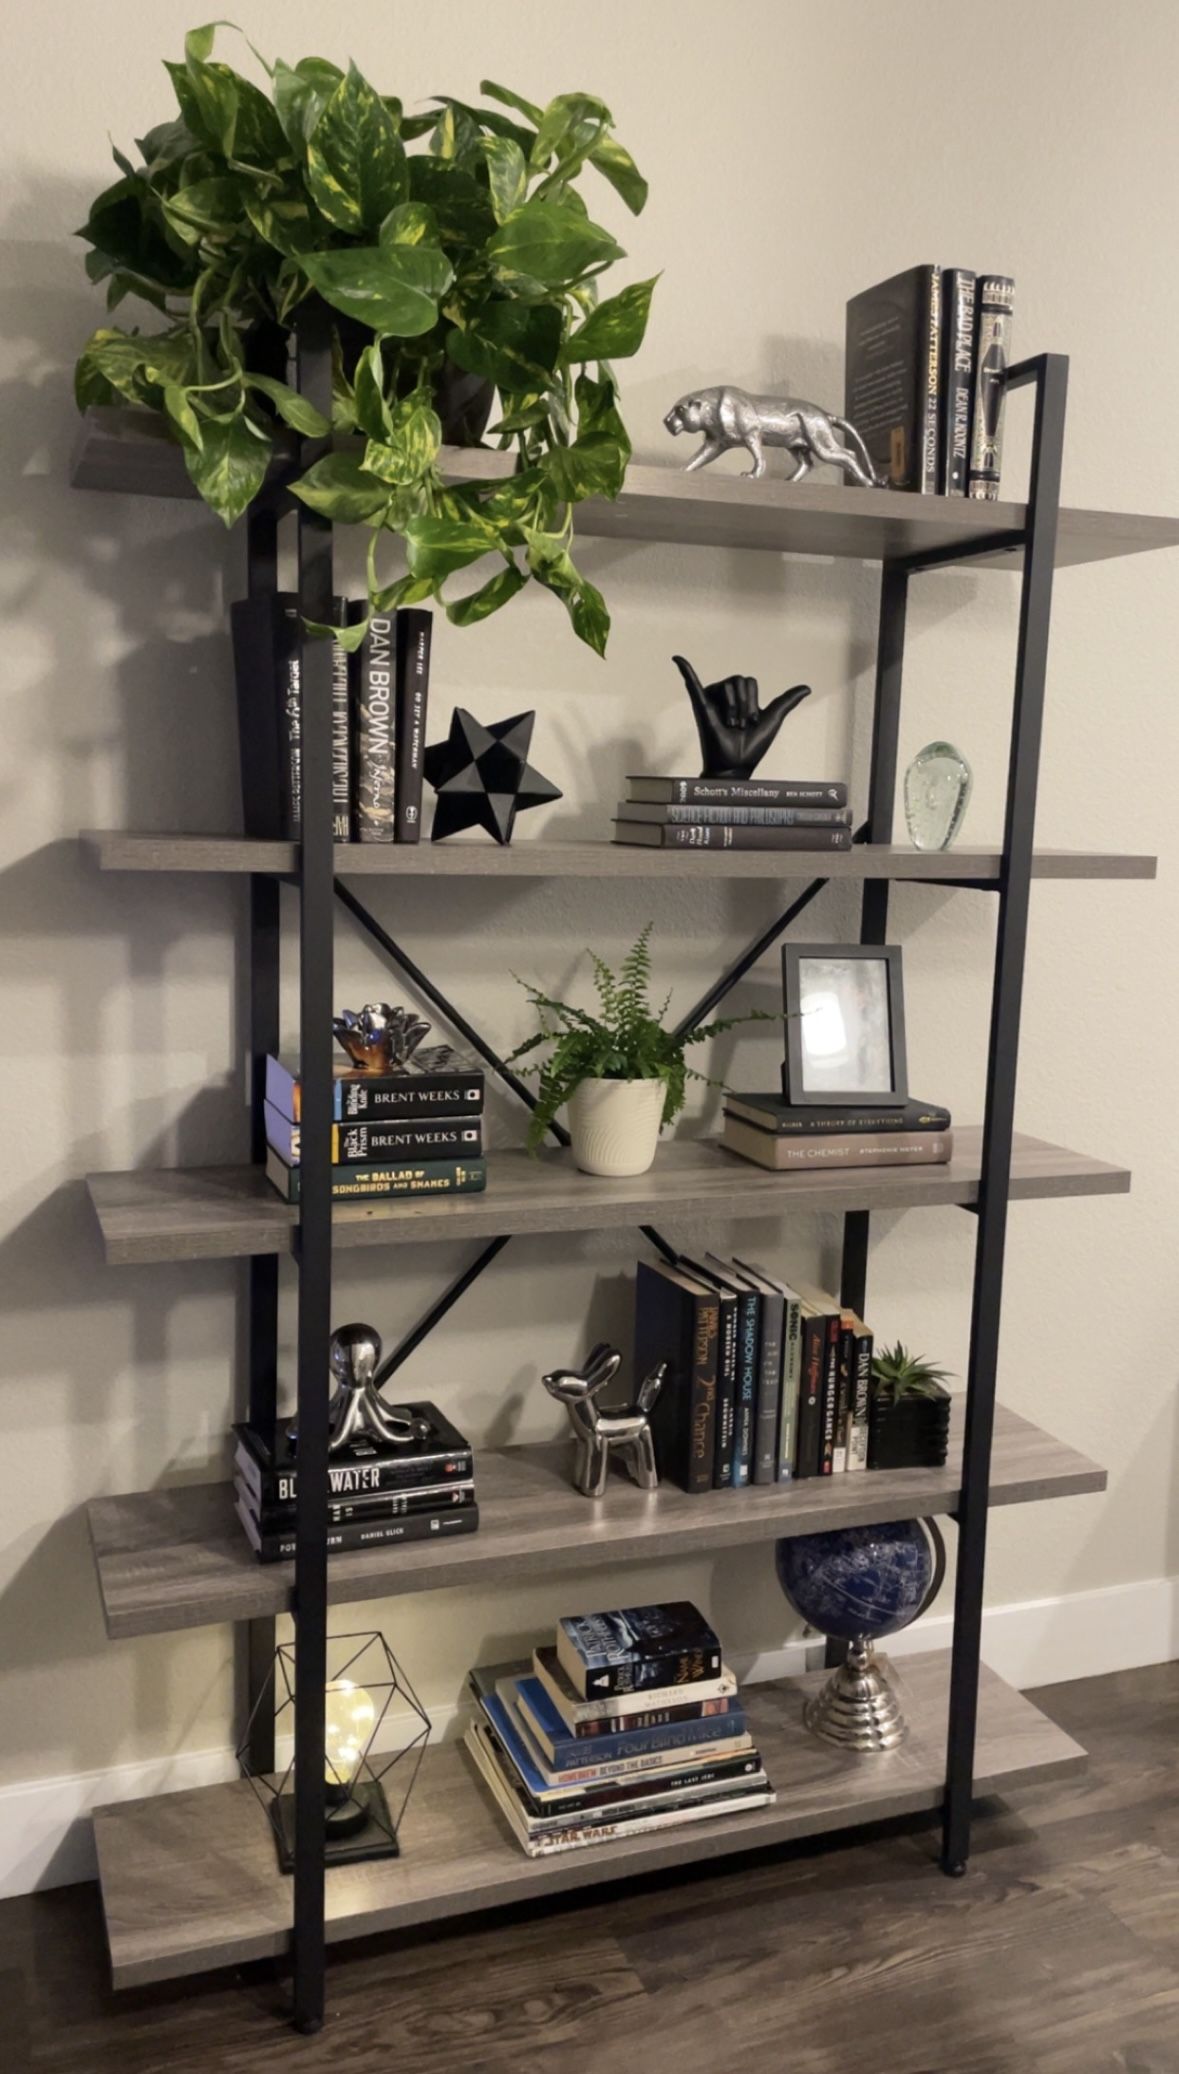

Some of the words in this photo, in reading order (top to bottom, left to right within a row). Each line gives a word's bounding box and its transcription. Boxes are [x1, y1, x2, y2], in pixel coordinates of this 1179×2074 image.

[929, 273, 940, 320] JAMES
[957, 272, 976, 303] THE
[957, 303, 973, 332] BAD
[926, 320, 939, 395] PATTERSON
[954, 332, 972, 373] PLACE
[927, 396, 937, 410] 22
[955, 387, 969, 413] DEAN
[926, 412, 937, 473] SECONDS
[952, 421, 968, 459] KOONTZ
[369, 617, 391, 666] DAN
[287, 659, 300, 696] Target
[368, 670, 390, 754] BROWN
[288, 720, 300, 741] The
[693, 786, 728, 797] Schott's
[730, 786, 780, 800] Miscellany
[358, 1089, 368, 1109] Knife
[374, 1092, 414, 1103] BRENT
[417, 1089, 460, 1101] WEEKS
[347, 1128, 358, 1158] Black
[357, 1127, 368, 1157] Prism
[371, 1134, 412, 1147] BRENT
[415, 1131, 457, 1144] WEEKS
[787, 1150, 805, 1159] THE
[806, 1147, 851, 1158] CHEMIST
[332, 1181, 391, 1195] SONGBIRDS
[393, 1182, 408, 1190] AND
[410, 1178, 450, 1190] SNAKES
[355, 1173, 370, 1181] THE
[371, 1170, 413, 1182] BALLAD
[414, 1169, 425, 1178] OF
[746, 1296, 757, 1315] THE
[696, 1307, 711, 1365] PATTERSON
[788, 1303, 799, 1341] SONIC
[744, 1318, 756, 1365] SHADOW
[857, 1352, 870, 1377] DAN
[696, 1374, 715, 1401] 2nd
[742, 1366, 754, 1400] HOUSE
[827, 1370, 835, 1409] HUNGER
[855, 1379, 868, 1418] BROWN
[693, 1402, 710, 1458] Chance
[721, 1398, 729, 1448] BROWNSTEIN
[824, 1410, 833, 1441] GAMES
[360, 1530, 384, 1540] DANIEL
[599, 1762, 625, 1776] BEYOND
[625, 1760, 639, 1772] THE
[639, 1755, 663, 1769] BASICS
[670, 1779, 683, 1787] THE
[684, 1776, 699, 1785] LAST
[549, 1829, 581, 1846] STAR
[582, 1826, 617, 1841] WARS
